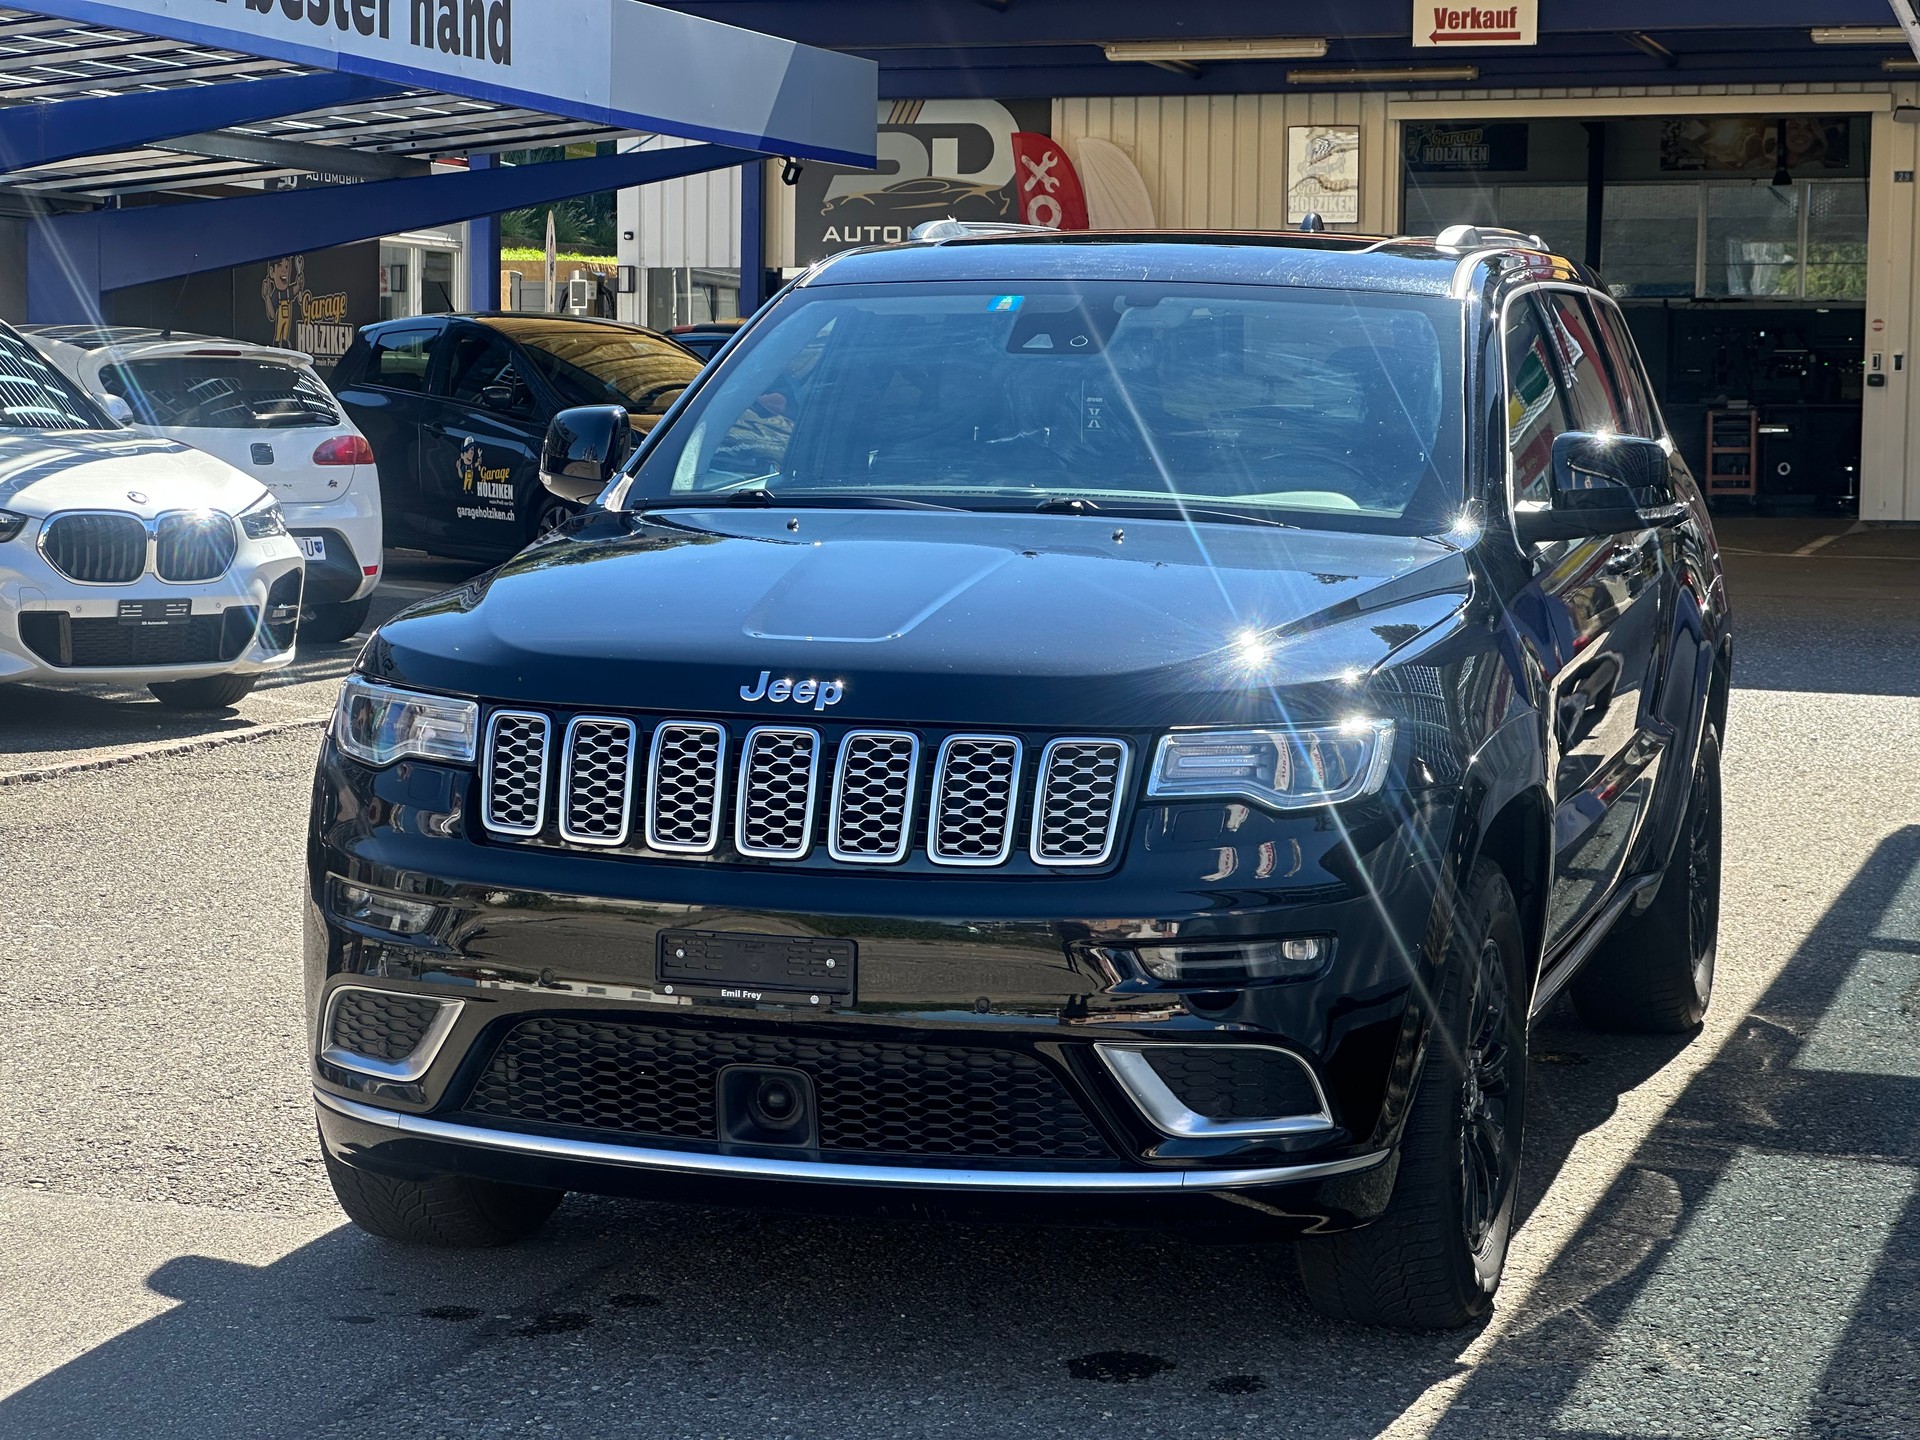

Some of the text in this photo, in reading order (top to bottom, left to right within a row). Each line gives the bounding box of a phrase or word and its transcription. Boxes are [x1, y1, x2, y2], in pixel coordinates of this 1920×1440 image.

[1434, 6, 1518, 30] Verkauf
[1424, 146, 1488, 162] HOLZIKEN
[1289, 195, 1357, 212] HOLZIKEN
[822, 225, 911, 242] AUTO
[302, 291, 346, 324] Garage
[297, 323, 353, 354] HOLZIKEN
[480, 466, 510, 483] Garage
[476, 481, 514, 500] HOLZIKEN
[456, 506, 516, 521] garageholziken.ch
[740, 671, 843, 711] Jeep
[721, 989, 762, 1001] Emil Frey
